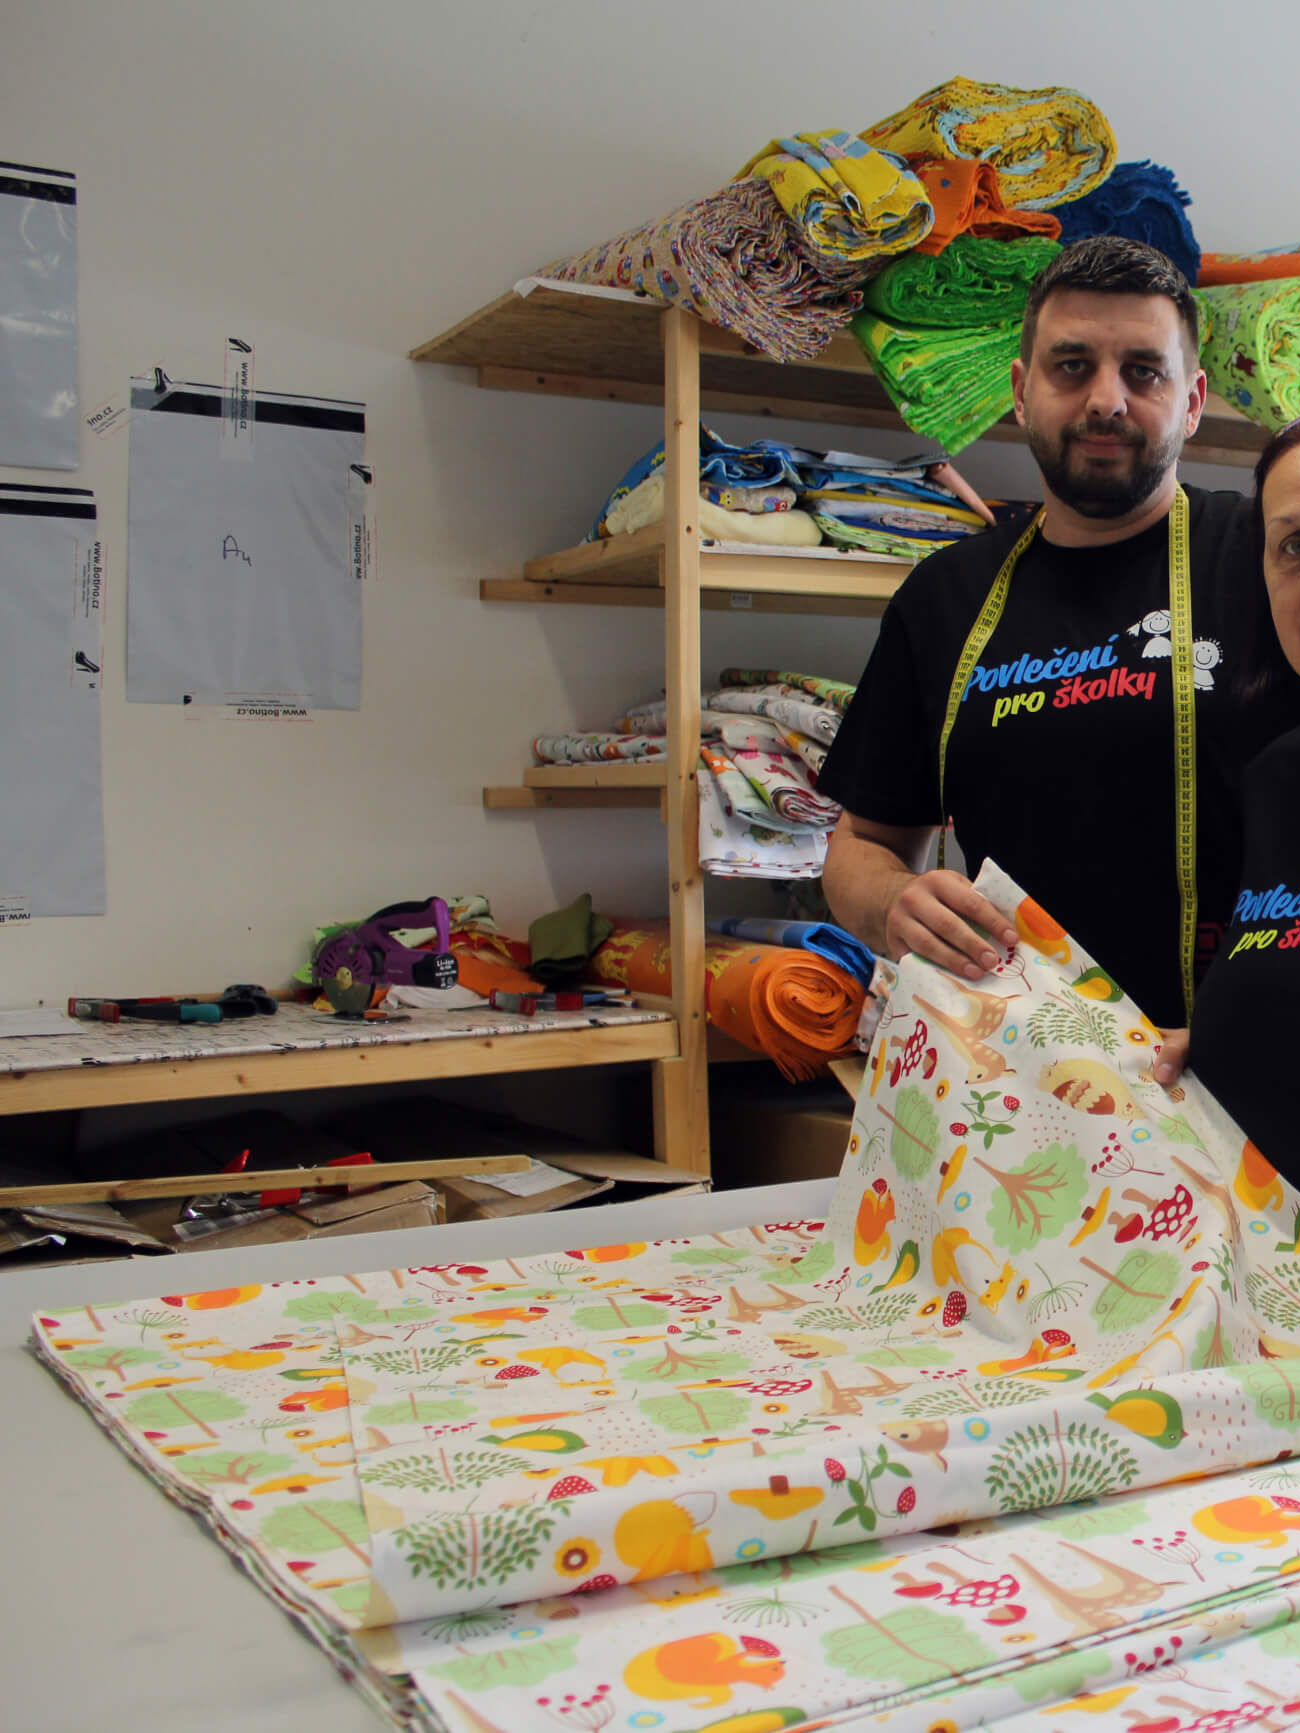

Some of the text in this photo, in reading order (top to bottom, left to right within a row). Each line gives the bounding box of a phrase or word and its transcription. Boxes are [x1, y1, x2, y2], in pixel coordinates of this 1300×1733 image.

[92, 541, 102, 609] www.Botino.cz
[962, 634, 1120, 702] Povlečení
[991, 690, 1046, 727] pro
[1052, 667, 1157, 709] školky
[236, 707, 307, 717] www.Botino.cz
[1228, 929, 1278, 960] pro
